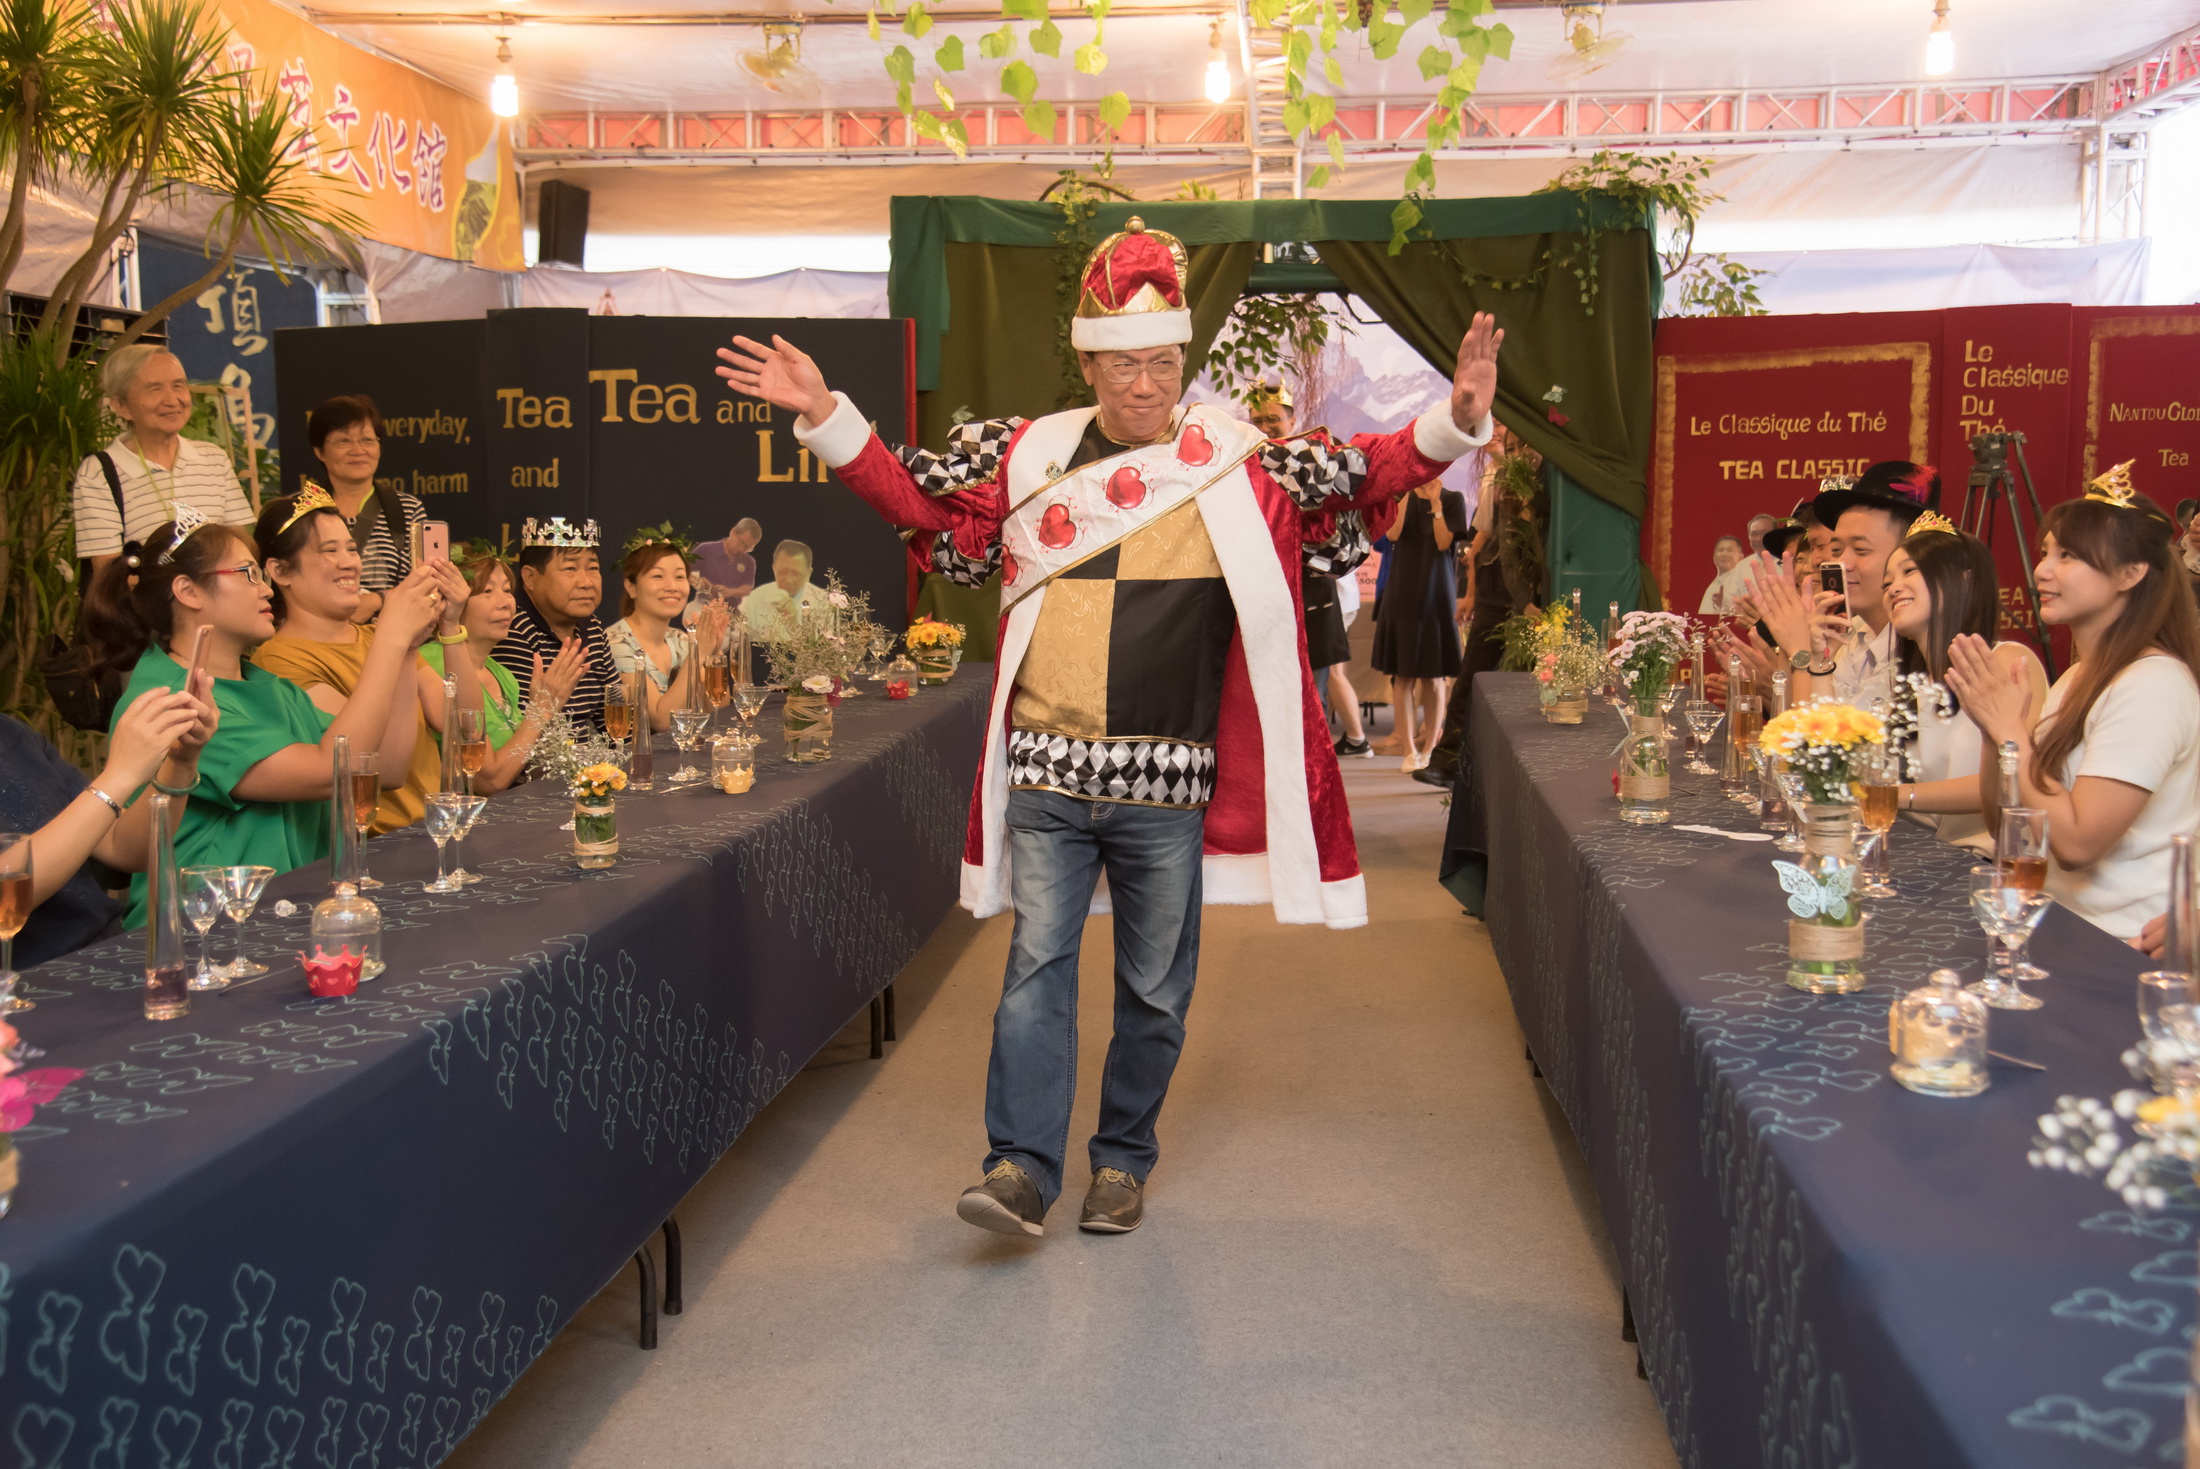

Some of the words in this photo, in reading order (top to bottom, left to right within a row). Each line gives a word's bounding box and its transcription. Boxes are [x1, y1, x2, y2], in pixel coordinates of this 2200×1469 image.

[1964, 339, 1993, 363] Le
[1963, 362, 2069, 390] Classique
[497, 388, 573, 429] Tea
[588, 368, 702, 424] Tea
[716, 399, 772, 424] and
[1961, 395, 1994, 416] Du
[381, 408, 471, 445] veryday,
[1690, 416, 1711, 436] Le
[1719, 413, 1812, 440] Classique
[1817, 411, 1842, 433] du
[1848, 411, 1887, 433] Thé
[1719, 460, 1764, 480] TEA
[1776, 458, 1870, 480] CLASSIC
[2158, 448, 2189, 467] Tea
[412, 469, 469, 495] harm
[511, 458, 560, 488] and
[1998, 586, 2025, 606] EA
